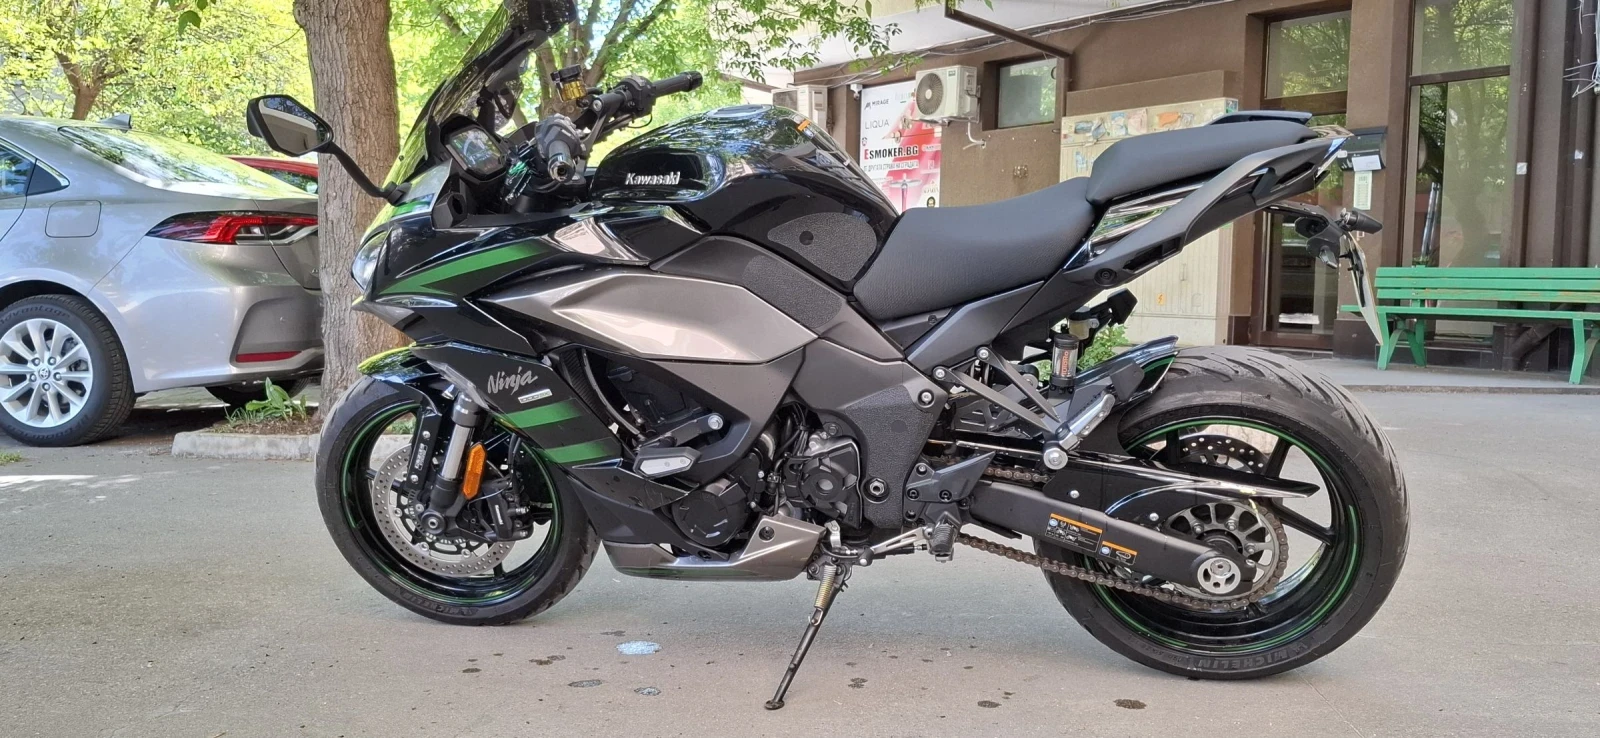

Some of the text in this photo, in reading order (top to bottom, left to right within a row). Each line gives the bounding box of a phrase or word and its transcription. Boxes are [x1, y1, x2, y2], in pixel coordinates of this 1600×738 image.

[865, 119, 889, 130] LIQUA
[864, 146, 918, 160] ESMOKER.BG
[625, 171, 681, 185] Kawasaki
[487, 366, 538, 395] Ninja
[403, 590, 460, 615] MICHELIN
[1197, 650, 1286, 670] MICHELIN
